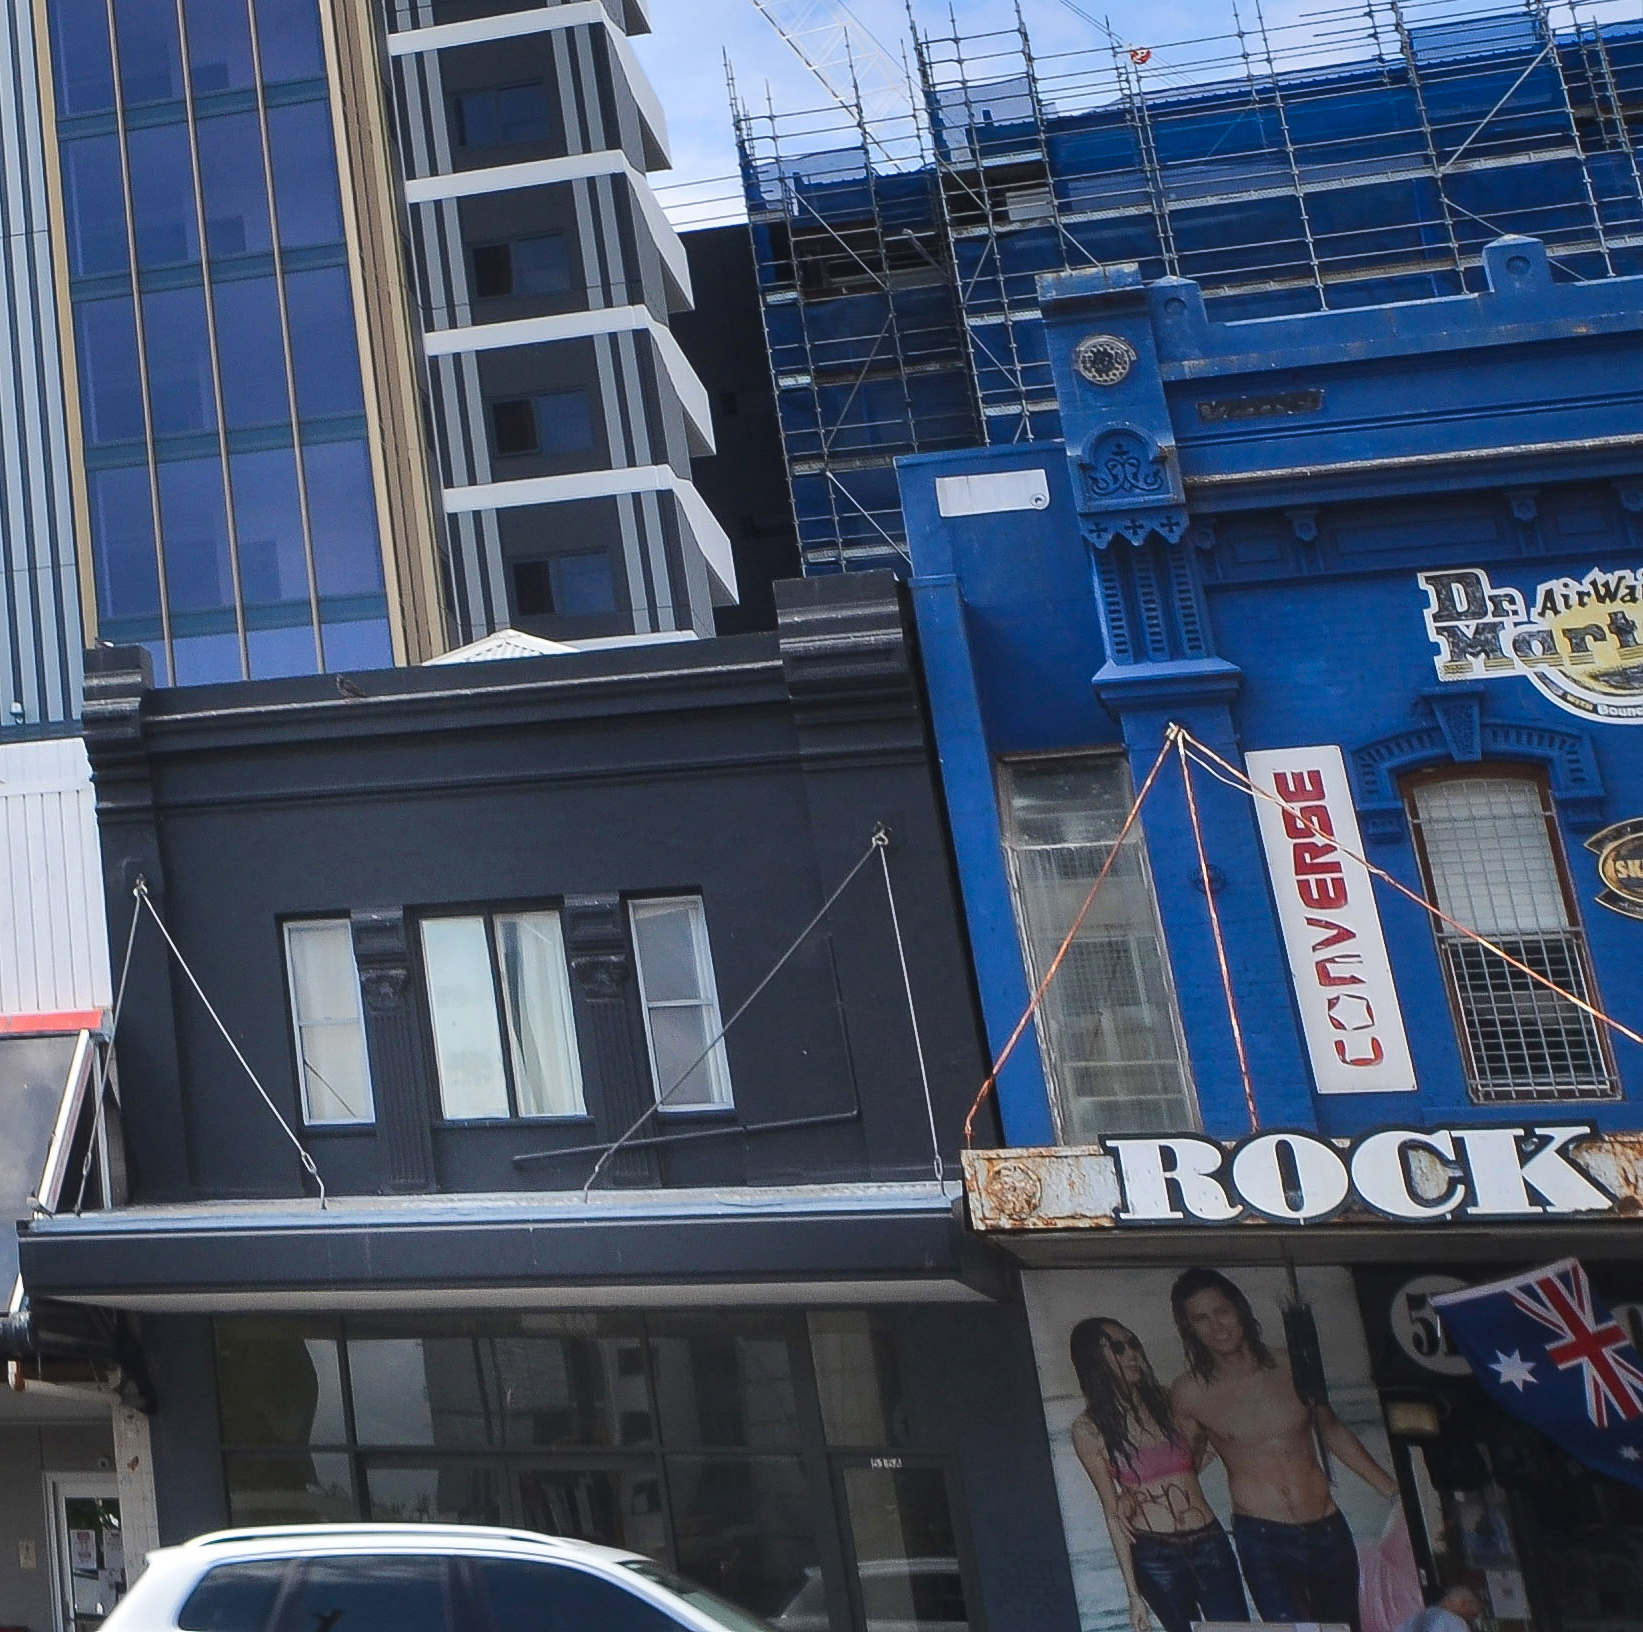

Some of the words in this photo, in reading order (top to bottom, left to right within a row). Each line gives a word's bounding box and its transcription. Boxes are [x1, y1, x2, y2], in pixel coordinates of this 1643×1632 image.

[1537, 574, 1643, 618] AirWa
[1273, 768, 1385, 1067] CONVERSE
[1106, 1126, 1614, 1225] ROCK
